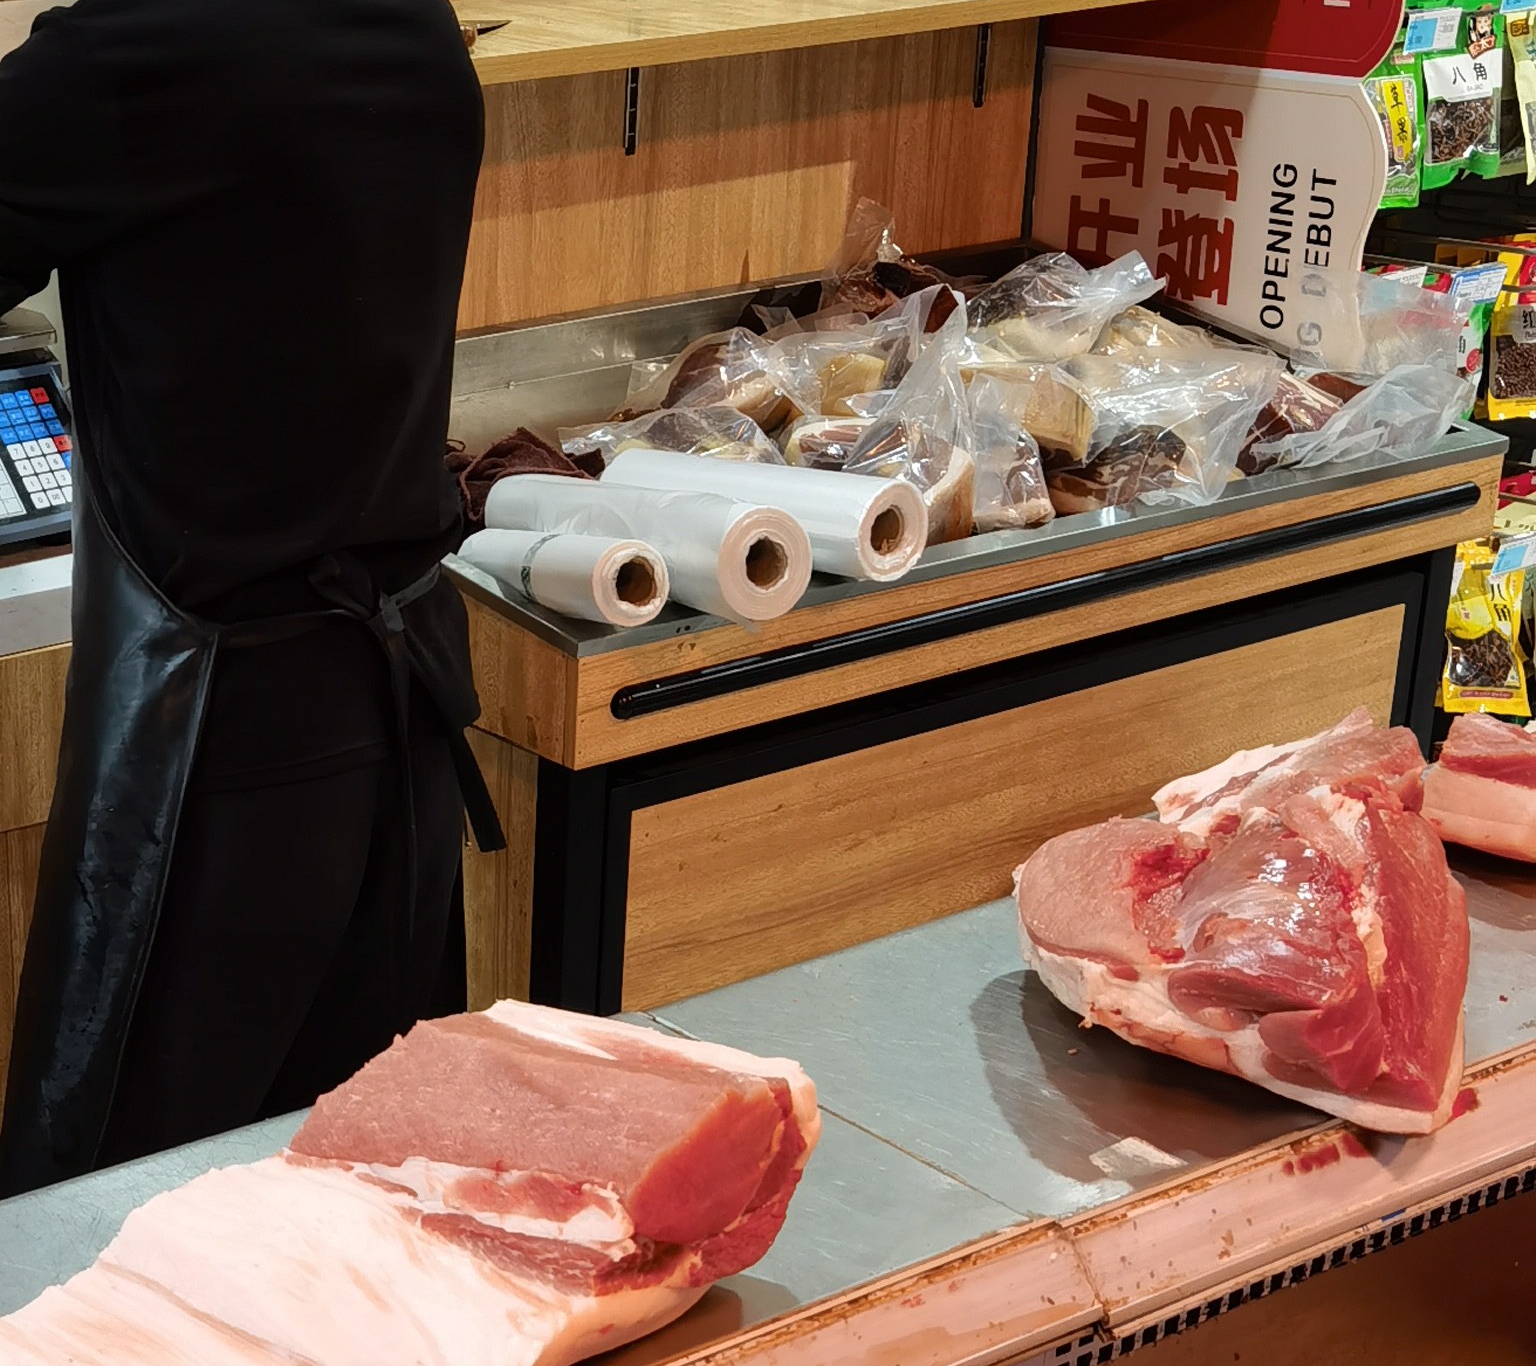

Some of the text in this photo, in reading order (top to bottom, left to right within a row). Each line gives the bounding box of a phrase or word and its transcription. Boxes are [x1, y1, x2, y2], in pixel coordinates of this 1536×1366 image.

[1452, 63, 1488, 85] 八角
[1156, 105, 1244, 306] 登场
[1259, 163, 1298, 329] OPENING
